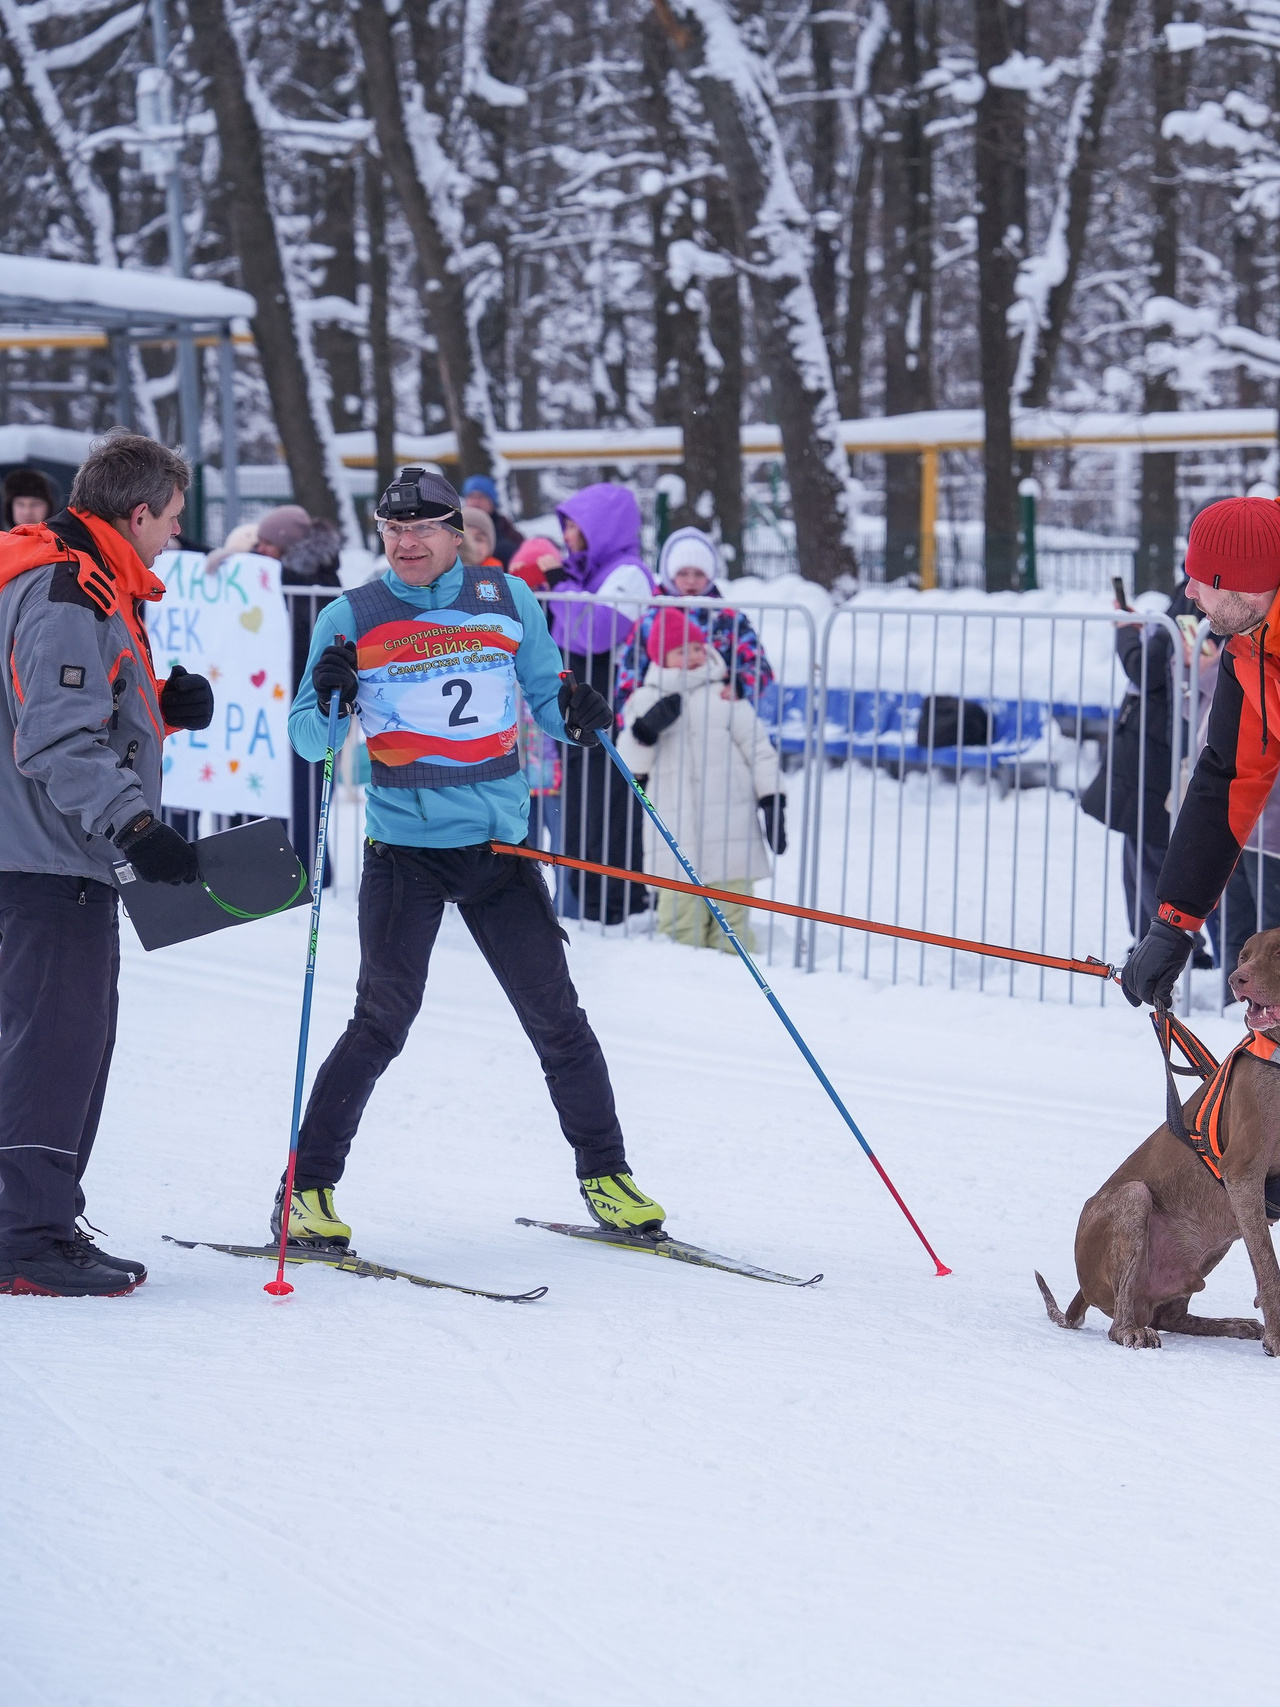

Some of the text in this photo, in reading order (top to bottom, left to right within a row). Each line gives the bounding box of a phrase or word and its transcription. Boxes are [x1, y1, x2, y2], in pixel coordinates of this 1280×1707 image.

[384, 624, 503, 651] Спортивная школа
[414, 636, 483, 658] Чайка
[388, 652, 509, 676] Самарская область
[442, 678, 479, 727] 2
